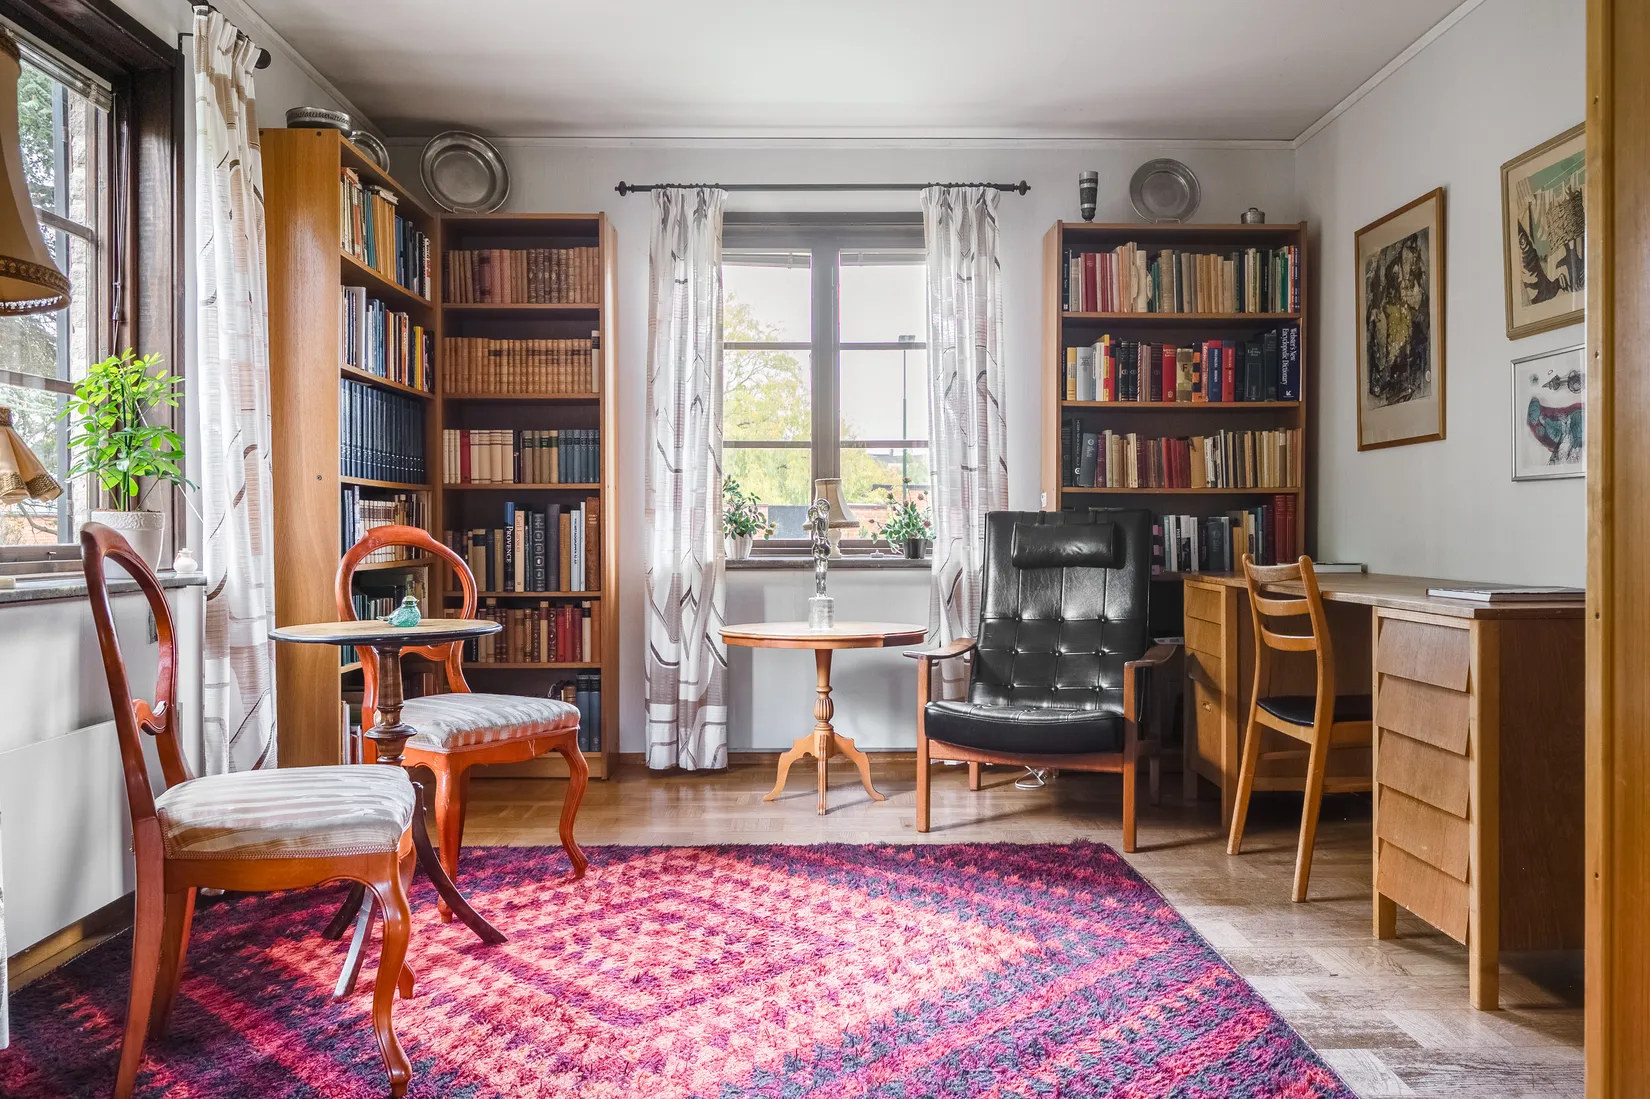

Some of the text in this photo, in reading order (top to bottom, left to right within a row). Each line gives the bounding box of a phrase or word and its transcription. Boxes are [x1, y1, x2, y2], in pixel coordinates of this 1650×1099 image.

[1182, 363, 1188, 372] F
[1280, 328, 1289, 385] Encyclopedic Dictionary
[505, 526, 514, 563] PROVENCE
